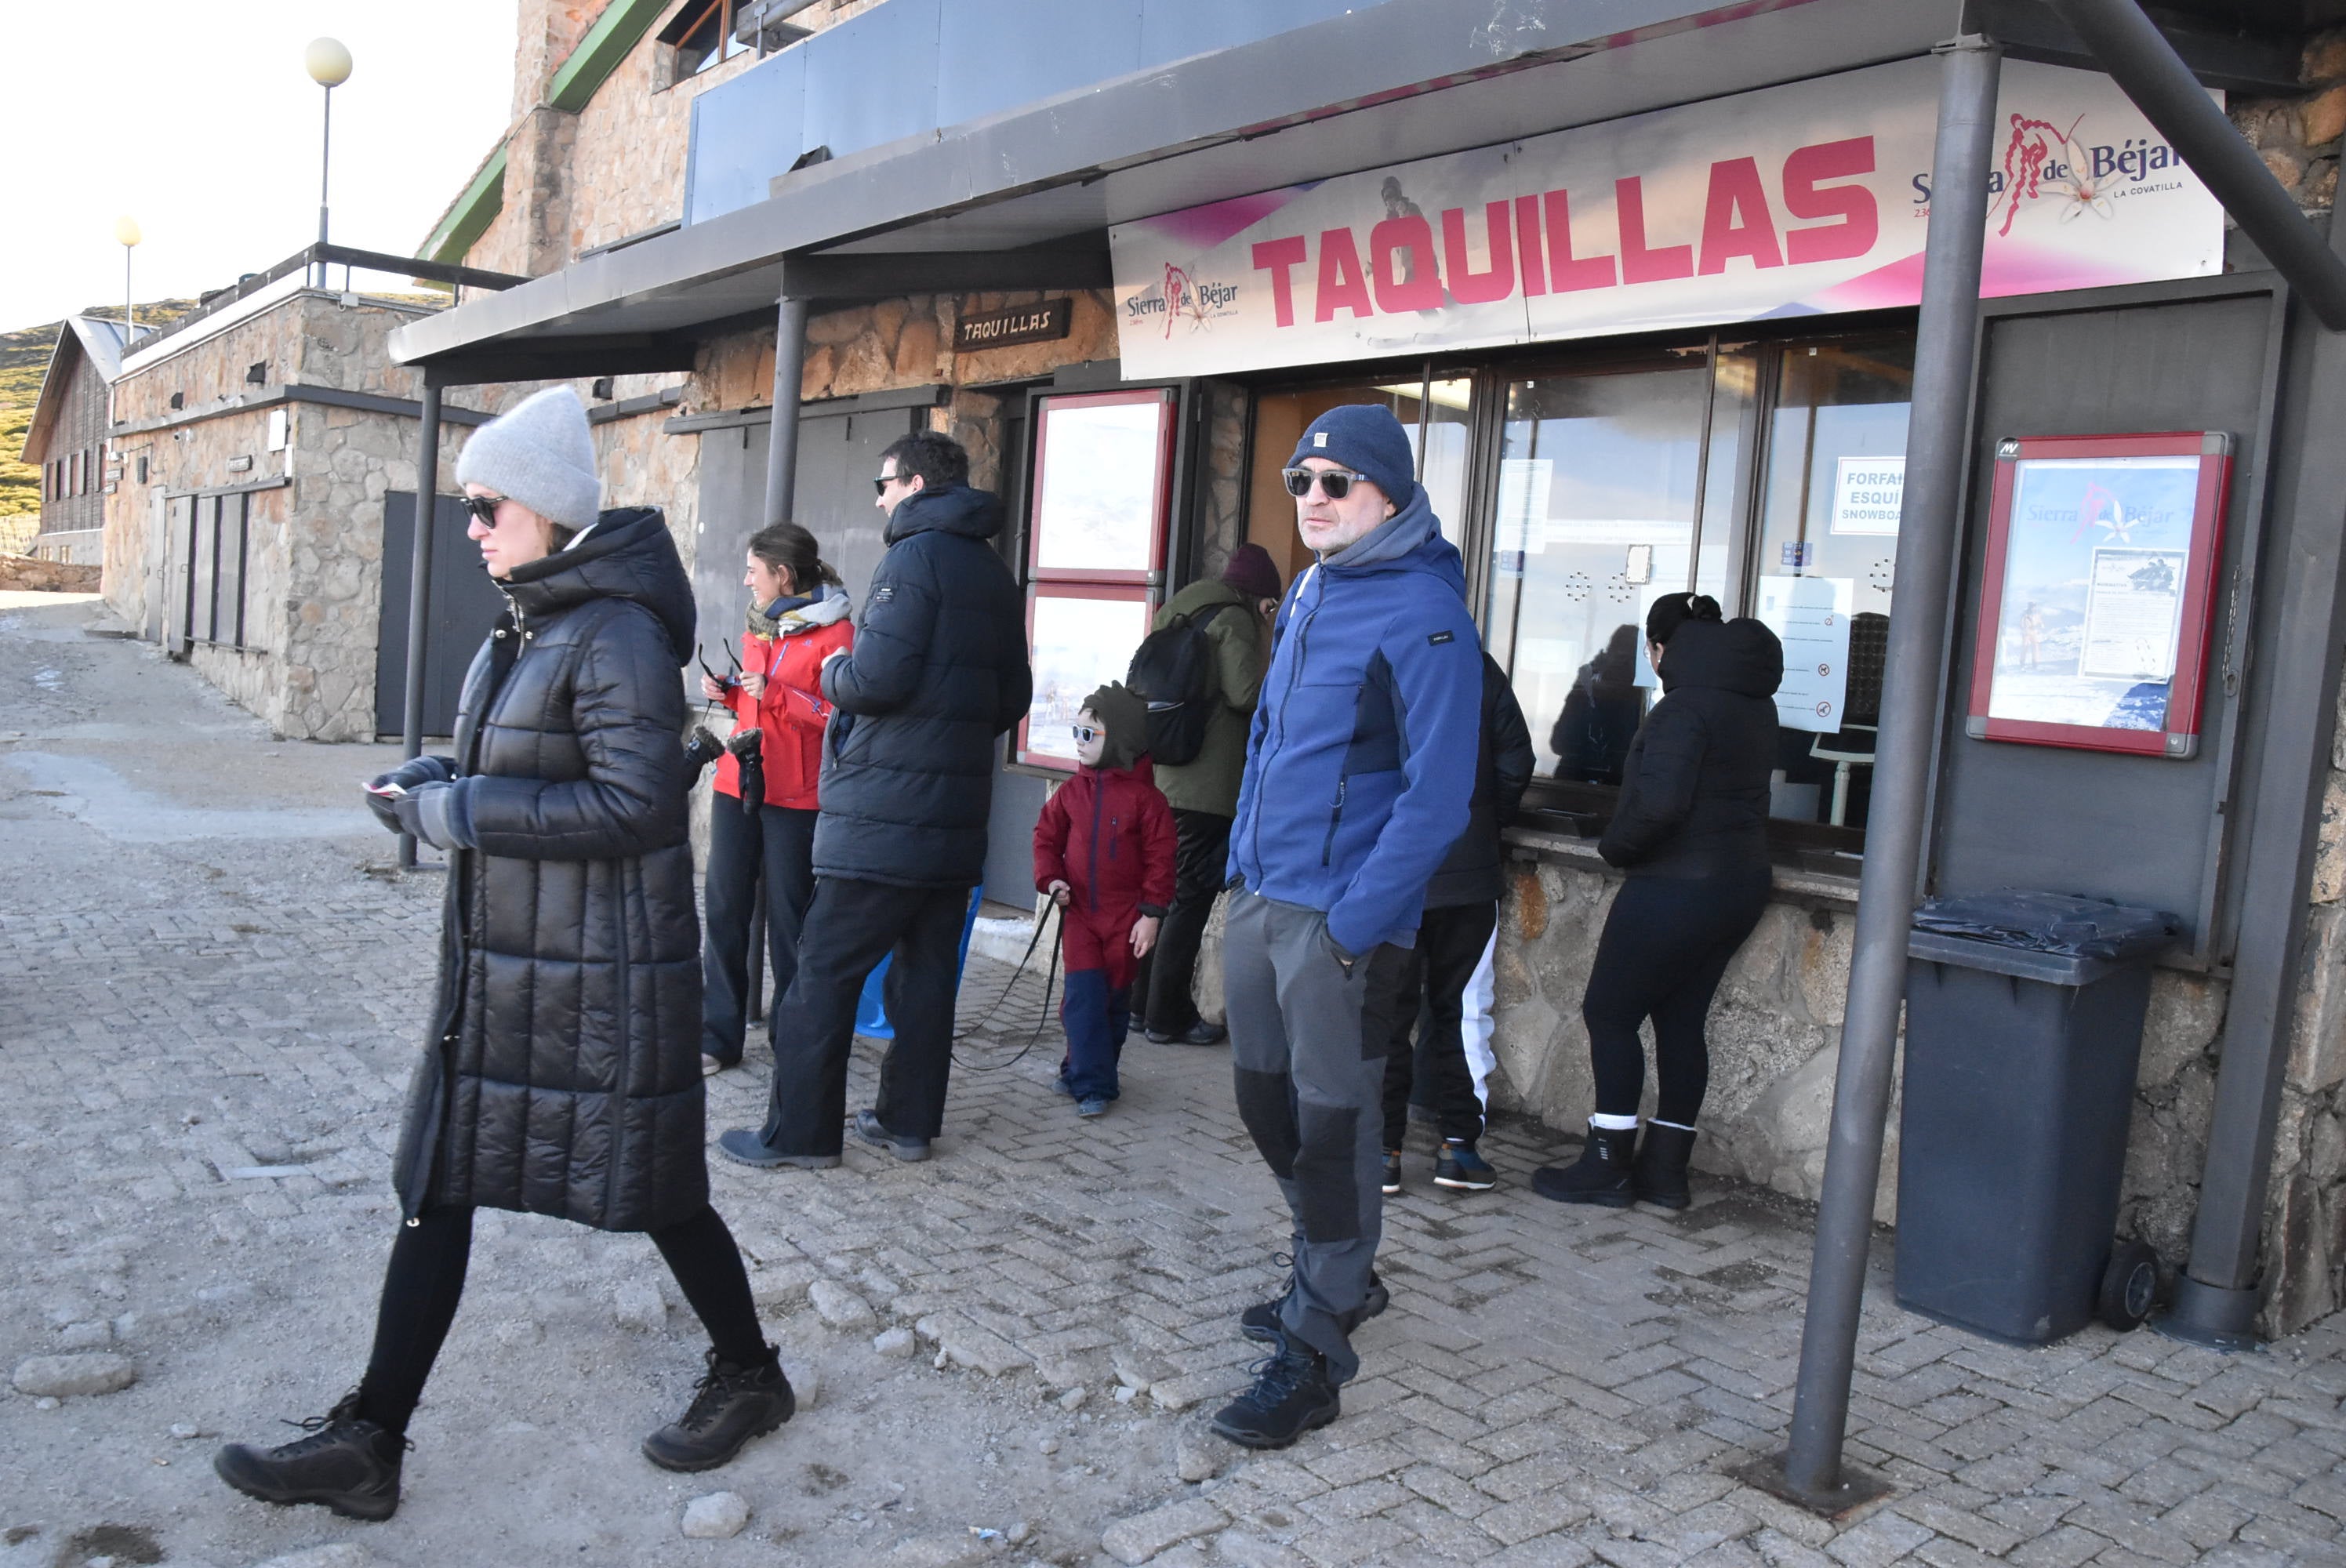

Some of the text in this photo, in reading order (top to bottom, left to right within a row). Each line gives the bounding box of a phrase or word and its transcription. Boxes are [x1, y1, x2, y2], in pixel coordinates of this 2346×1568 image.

[2043, 159, 2068, 180] de
[2130, 181, 2183, 196] COVATILLA
[1251, 135, 1879, 328] TAQUILLAS
[1128, 281, 1238, 317] Sierra de Béjar
[964, 311, 1051, 340] TAQUILLAS
[1847, 473, 1903, 485] FORFAI
[1850, 489, 1900, 505] ESQUÍ
[1843, 510, 1901, 520] SNOWBOA
[2026, 504, 2078, 521] Sierra
[2124, 506, 2174, 527] Béjar
